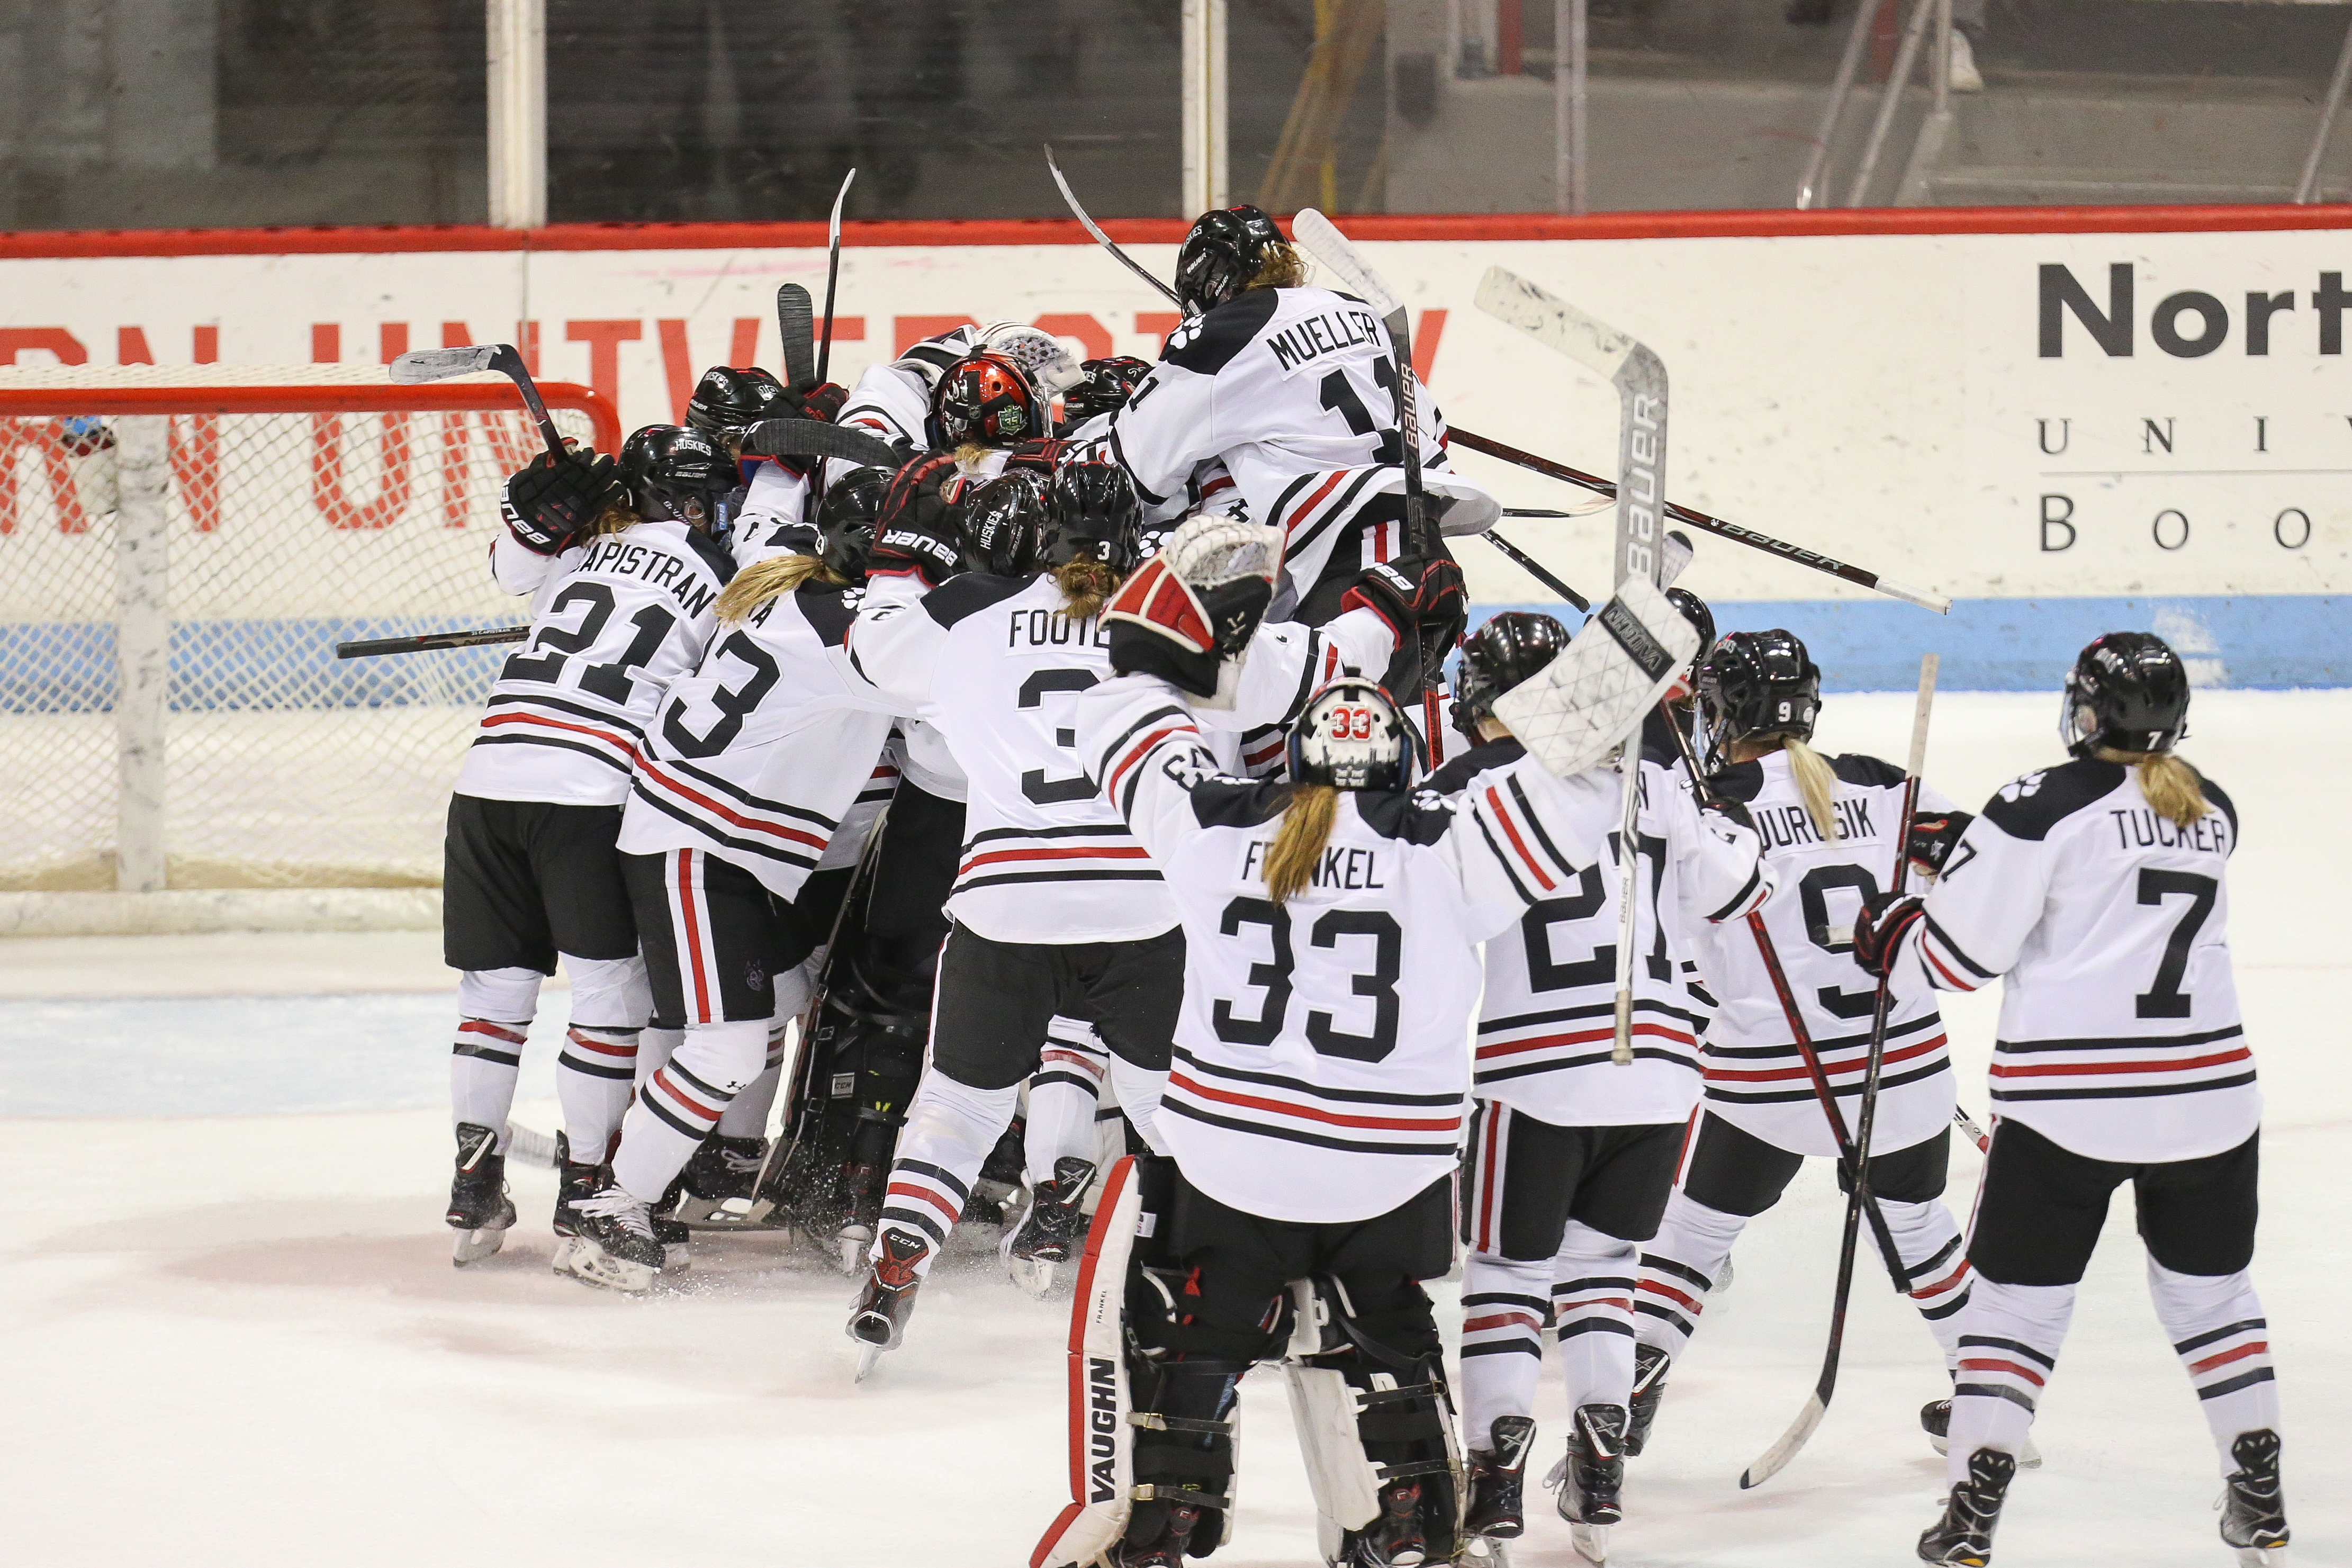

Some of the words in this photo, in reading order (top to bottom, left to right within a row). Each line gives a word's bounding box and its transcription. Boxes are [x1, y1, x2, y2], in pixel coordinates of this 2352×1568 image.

[2038, 263, 2352, 358] Nort
[1266, 311, 1381, 372] MUELLER
[1319, 355, 1405, 464] 11
[1401, 363, 1419, 449] BAUER
[675, 440, 712, 456] HUSKIES
[2035, 416, 2352, 455] UNI
[1626, 392, 1659, 577] BAUER
[881, 529, 958, 567] BAUER
[980, 510, 1004, 550] HUSKIES
[1097, 541, 1111, 560] 3
[1720, 523, 1844, 570] BAUER
[570, 542, 718, 620] APISTRAN
[499, 581, 676, 706] 21
[1604, 607, 1662, 672] VAUGHN
[663, 629, 780, 759] 3
[1778, 702, 1791, 722] 9
[1329, 706, 1372, 740] 33
[2146, 731, 2164, 751] 7
[1242, 840, 1383, 889] FKEL
[1941, 839, 1977, 883] 7
[2136, 867, 2218, 1019] 7
[1212, 896, 1402, 1064] 33
[890, 1233, 921, 1249] CCM
[1096, 1290, 1107, 1323] FRANKEL
[1089, 1357, 1116, 1503] VAUGHN
